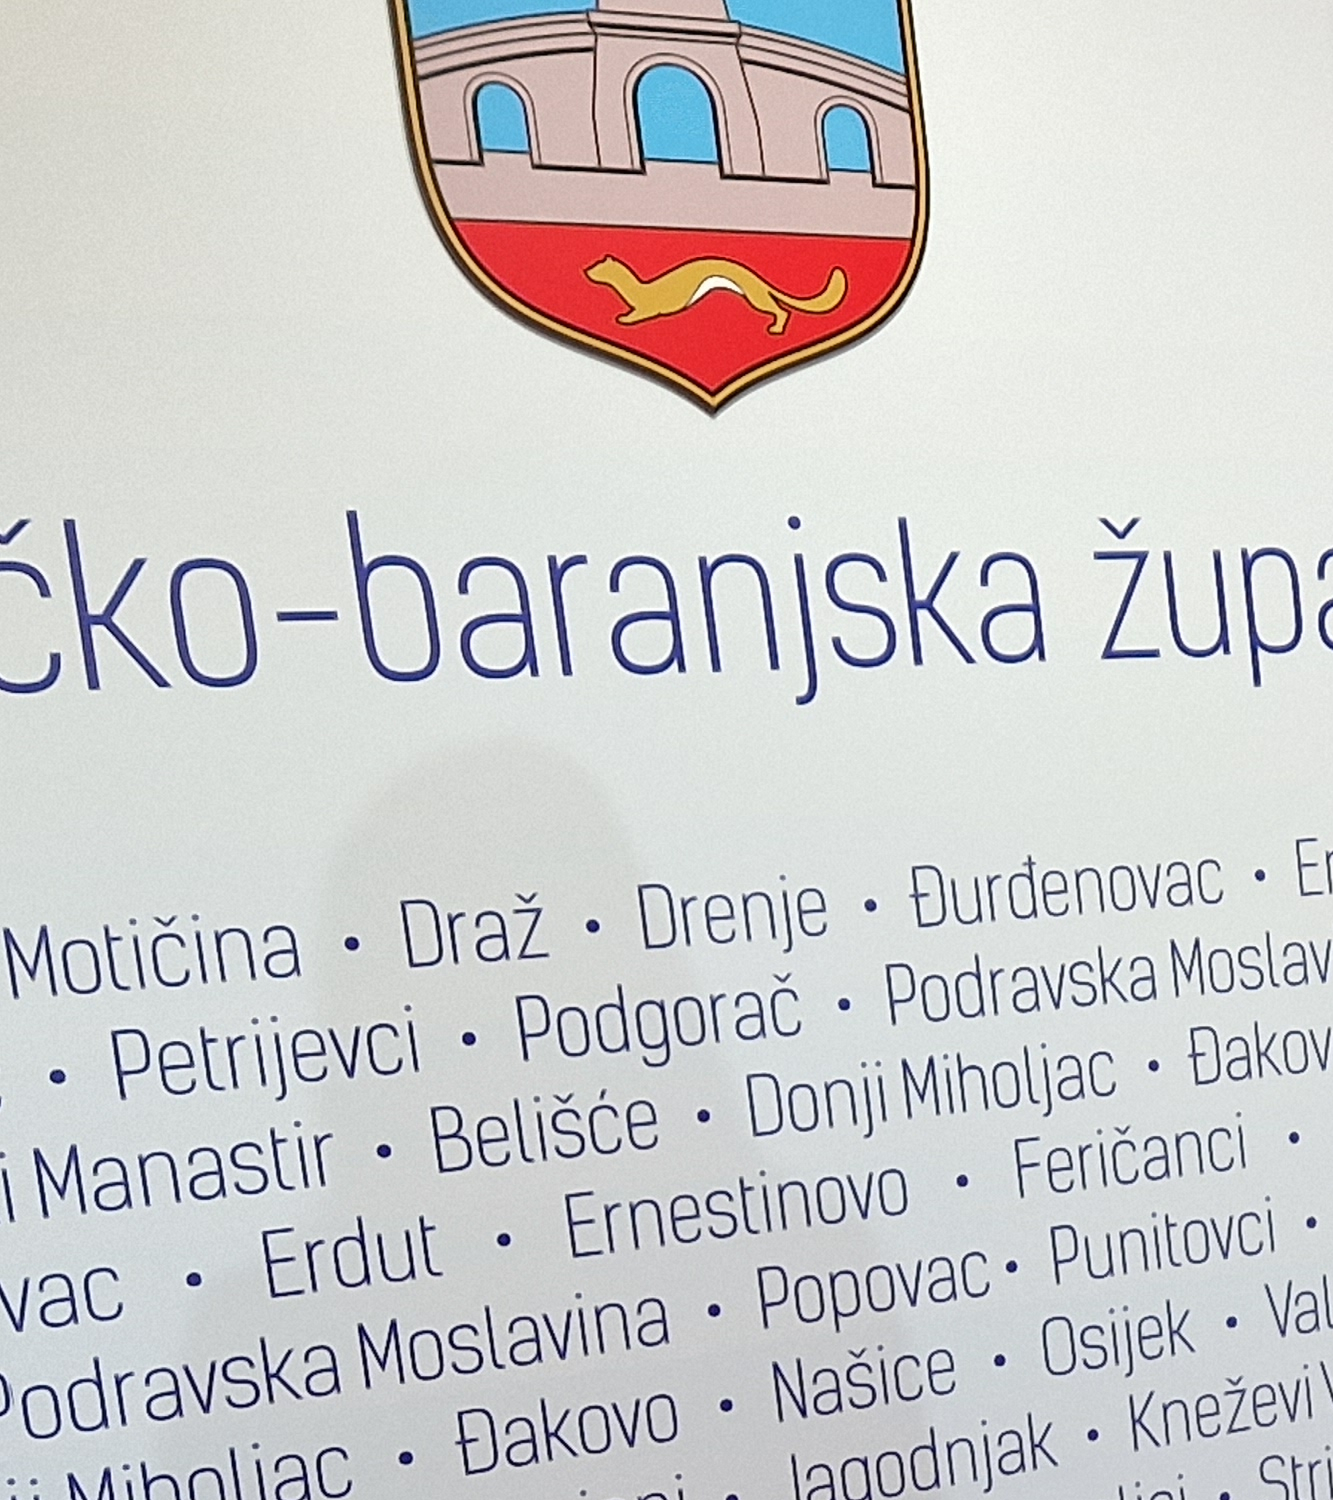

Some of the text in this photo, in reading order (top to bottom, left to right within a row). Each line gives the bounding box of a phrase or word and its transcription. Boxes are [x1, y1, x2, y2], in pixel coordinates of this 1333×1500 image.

[3, 914, 301, 1000] Motičina
[400, 892, 550, 968] Draž
[637, 875, 827, 954] Drenje
[909, 854, 1224, 928] Đurđenovac
[111, 1005, 419, 1102] Petrijevci
[515, 973, 802, 1068] Podgorač
[885, 945, 1157, 1026] Podravska
[33, 1121, 333, 1219] Manastir
[430, 1089, 658, 1173] Belišće
[746, 1060, 887, 1139] Donji
[901, 1043, 1116, 1120] Miholjac
[261, 1215, 443, 1298] Erdut
[565, 1168, 908, 1258] Ernestinovo
[1014, 1112, 1246, 1199] Feričanci
[357, 1293, 670, 1390] Moslavina
[757, 1251, 990, 1333] Popovac
[1050, 1196, 1275, 1286] Punitovci
[455, 1394, 678, 1476] Đakovo
[772, 1345, 956, 1423] Našice
[1042, 1299, 1196, 1378] Osijek
[1129, 1364, 1313, 1452] Kneževi
